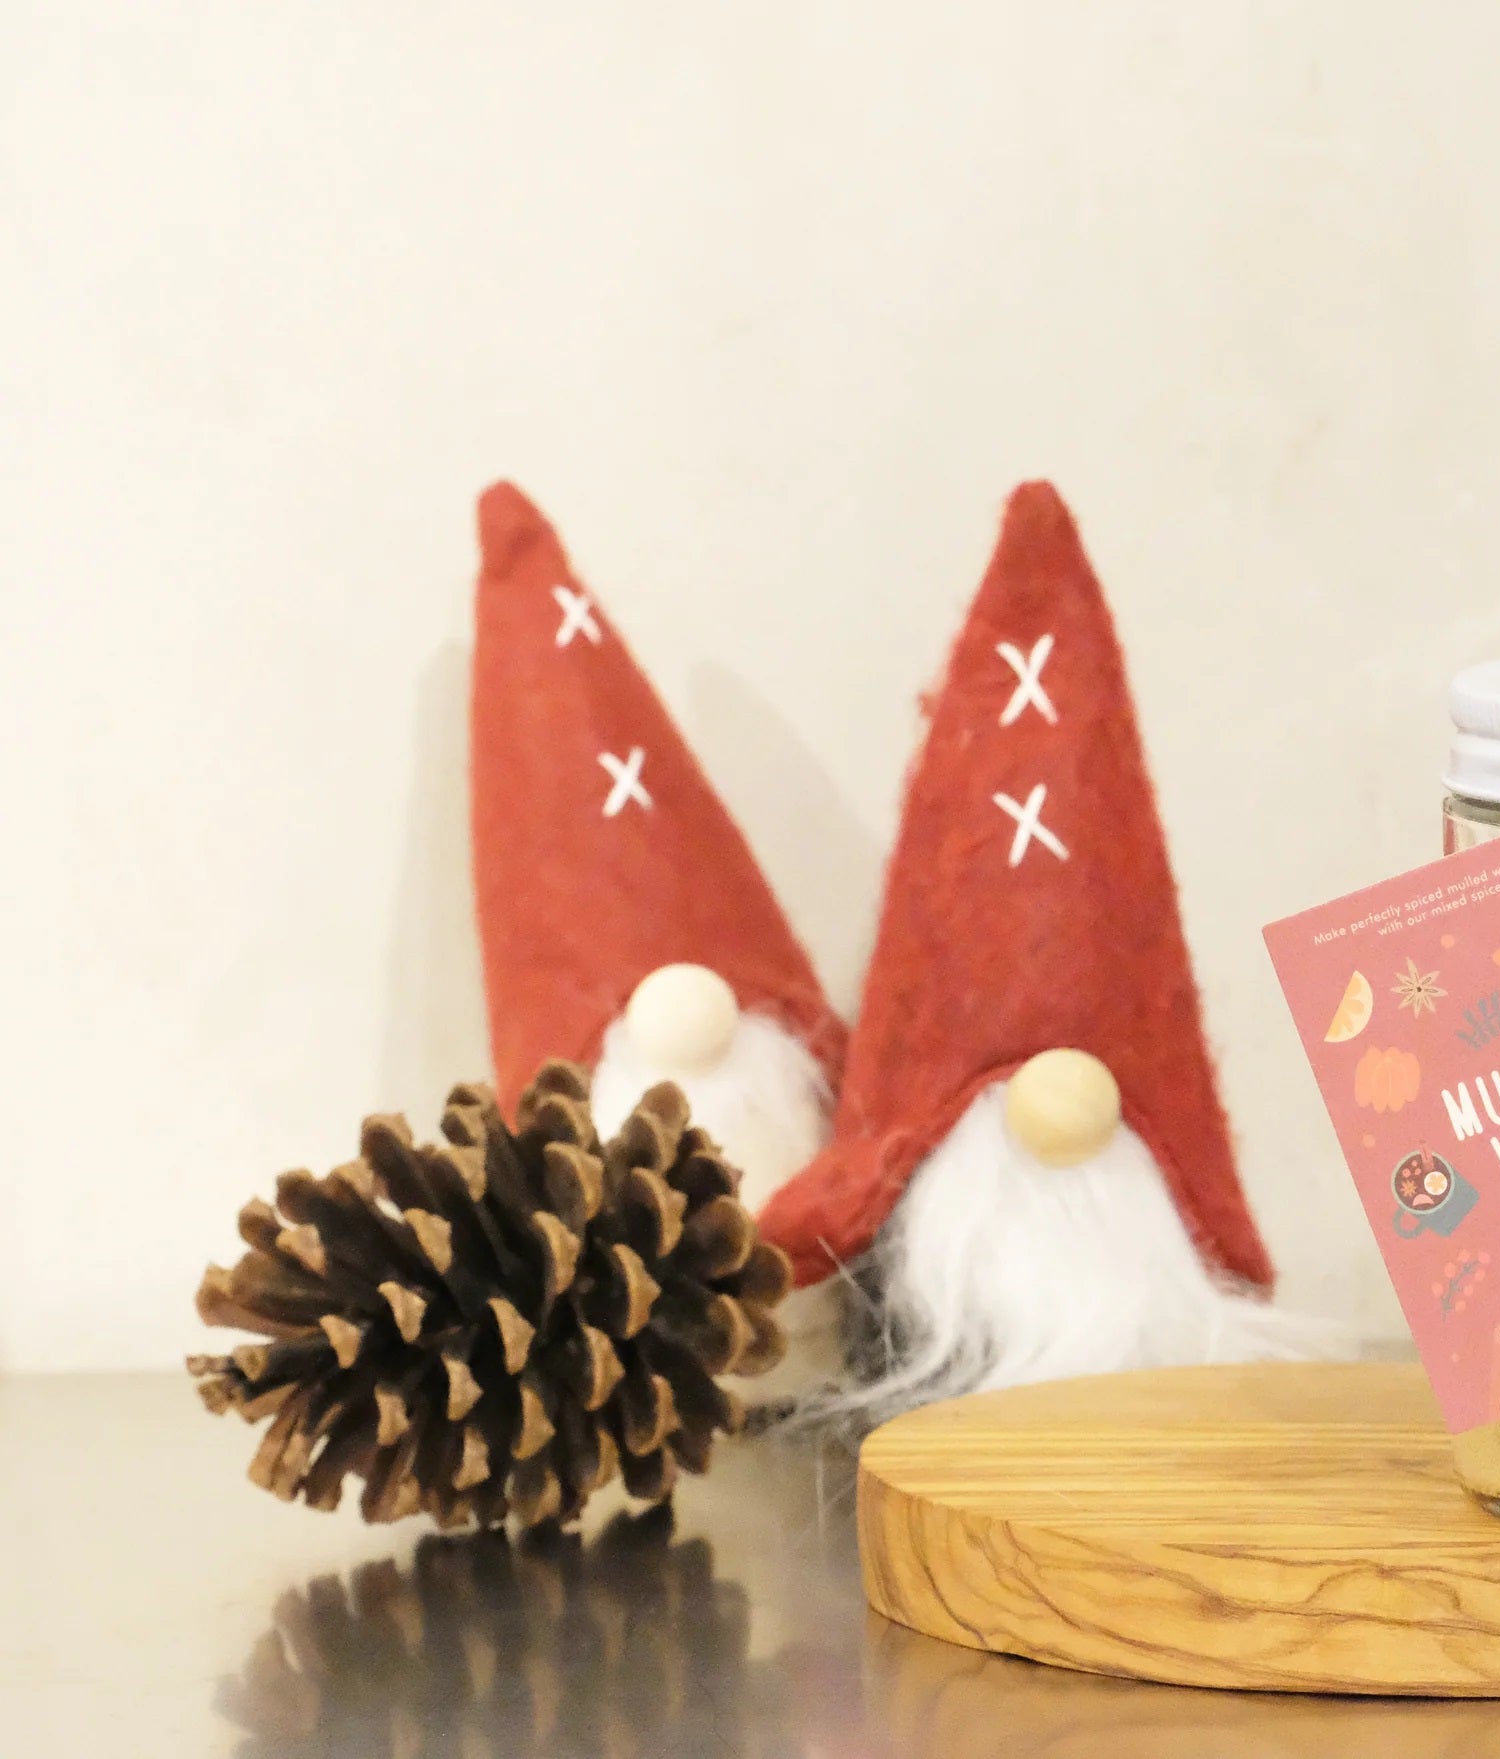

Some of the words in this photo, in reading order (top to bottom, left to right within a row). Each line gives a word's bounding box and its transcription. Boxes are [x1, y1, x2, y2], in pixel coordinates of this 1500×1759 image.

[1314, 927, 1346, 945] Make
[1350, 904, 1400, 934] perfectly
[1404, 886, 1443, 911] spiced
[1447, 870, 1488, 895] mulled
[1377, 918, 1403, 936] with
[1407, 912, 1427, 926] our
[1431, 894, 1467, 917] mixed
